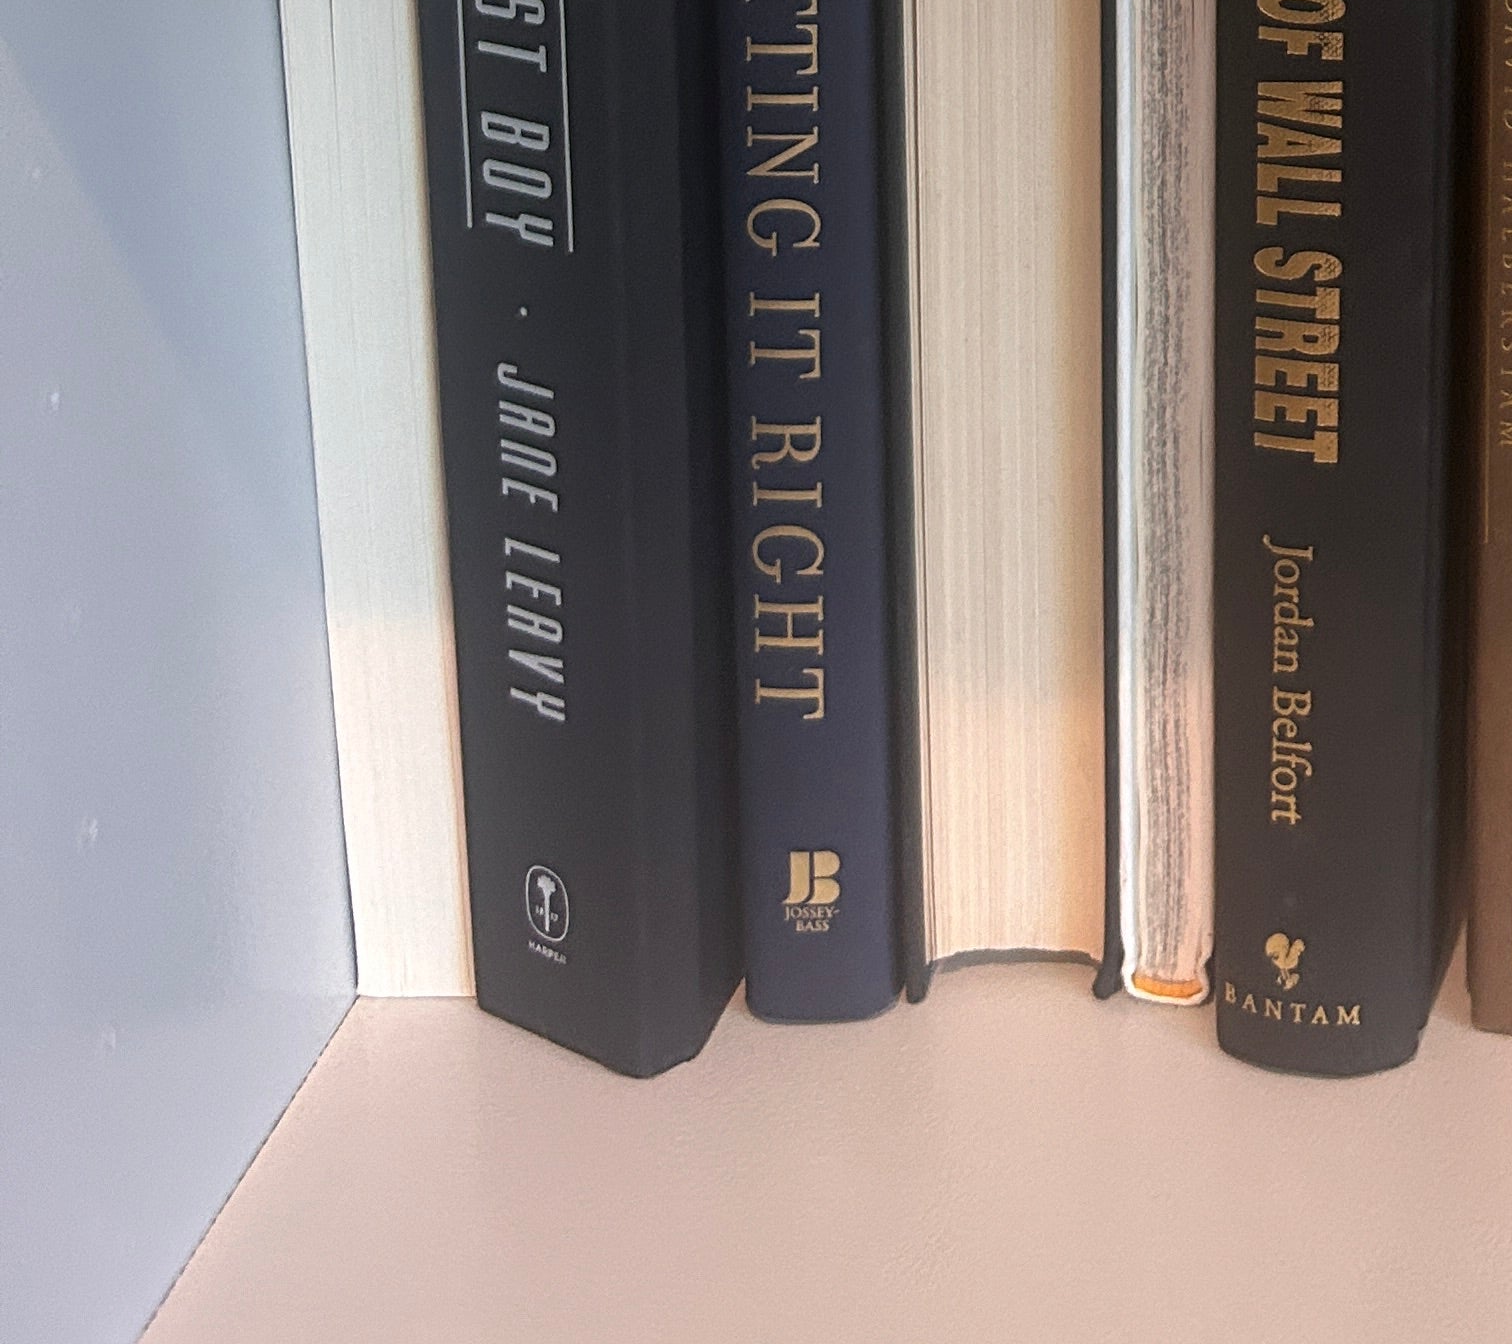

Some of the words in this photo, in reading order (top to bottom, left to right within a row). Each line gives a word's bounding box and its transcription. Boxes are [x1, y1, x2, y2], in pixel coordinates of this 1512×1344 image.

[480, 111, 554, 247] BOY
[1255, 81, 1344, 227] WALL
[749, 292, 821, 380] IT
[1253, 246, 1343, 465] STREET
[496, 362, 559, 513] JANE
[504, 537, 566, 723] LEAVY
[751, 415, 826, 721] RIGHT
[1262, 534, 1315, 674] Jordan
[1270, 686, 1314, 826] Belfort
[528, 940, 567, 965] HARPER
[795, 920, 830, 932] BASS
[1224, 982, 1363, 1026] BANTAM
